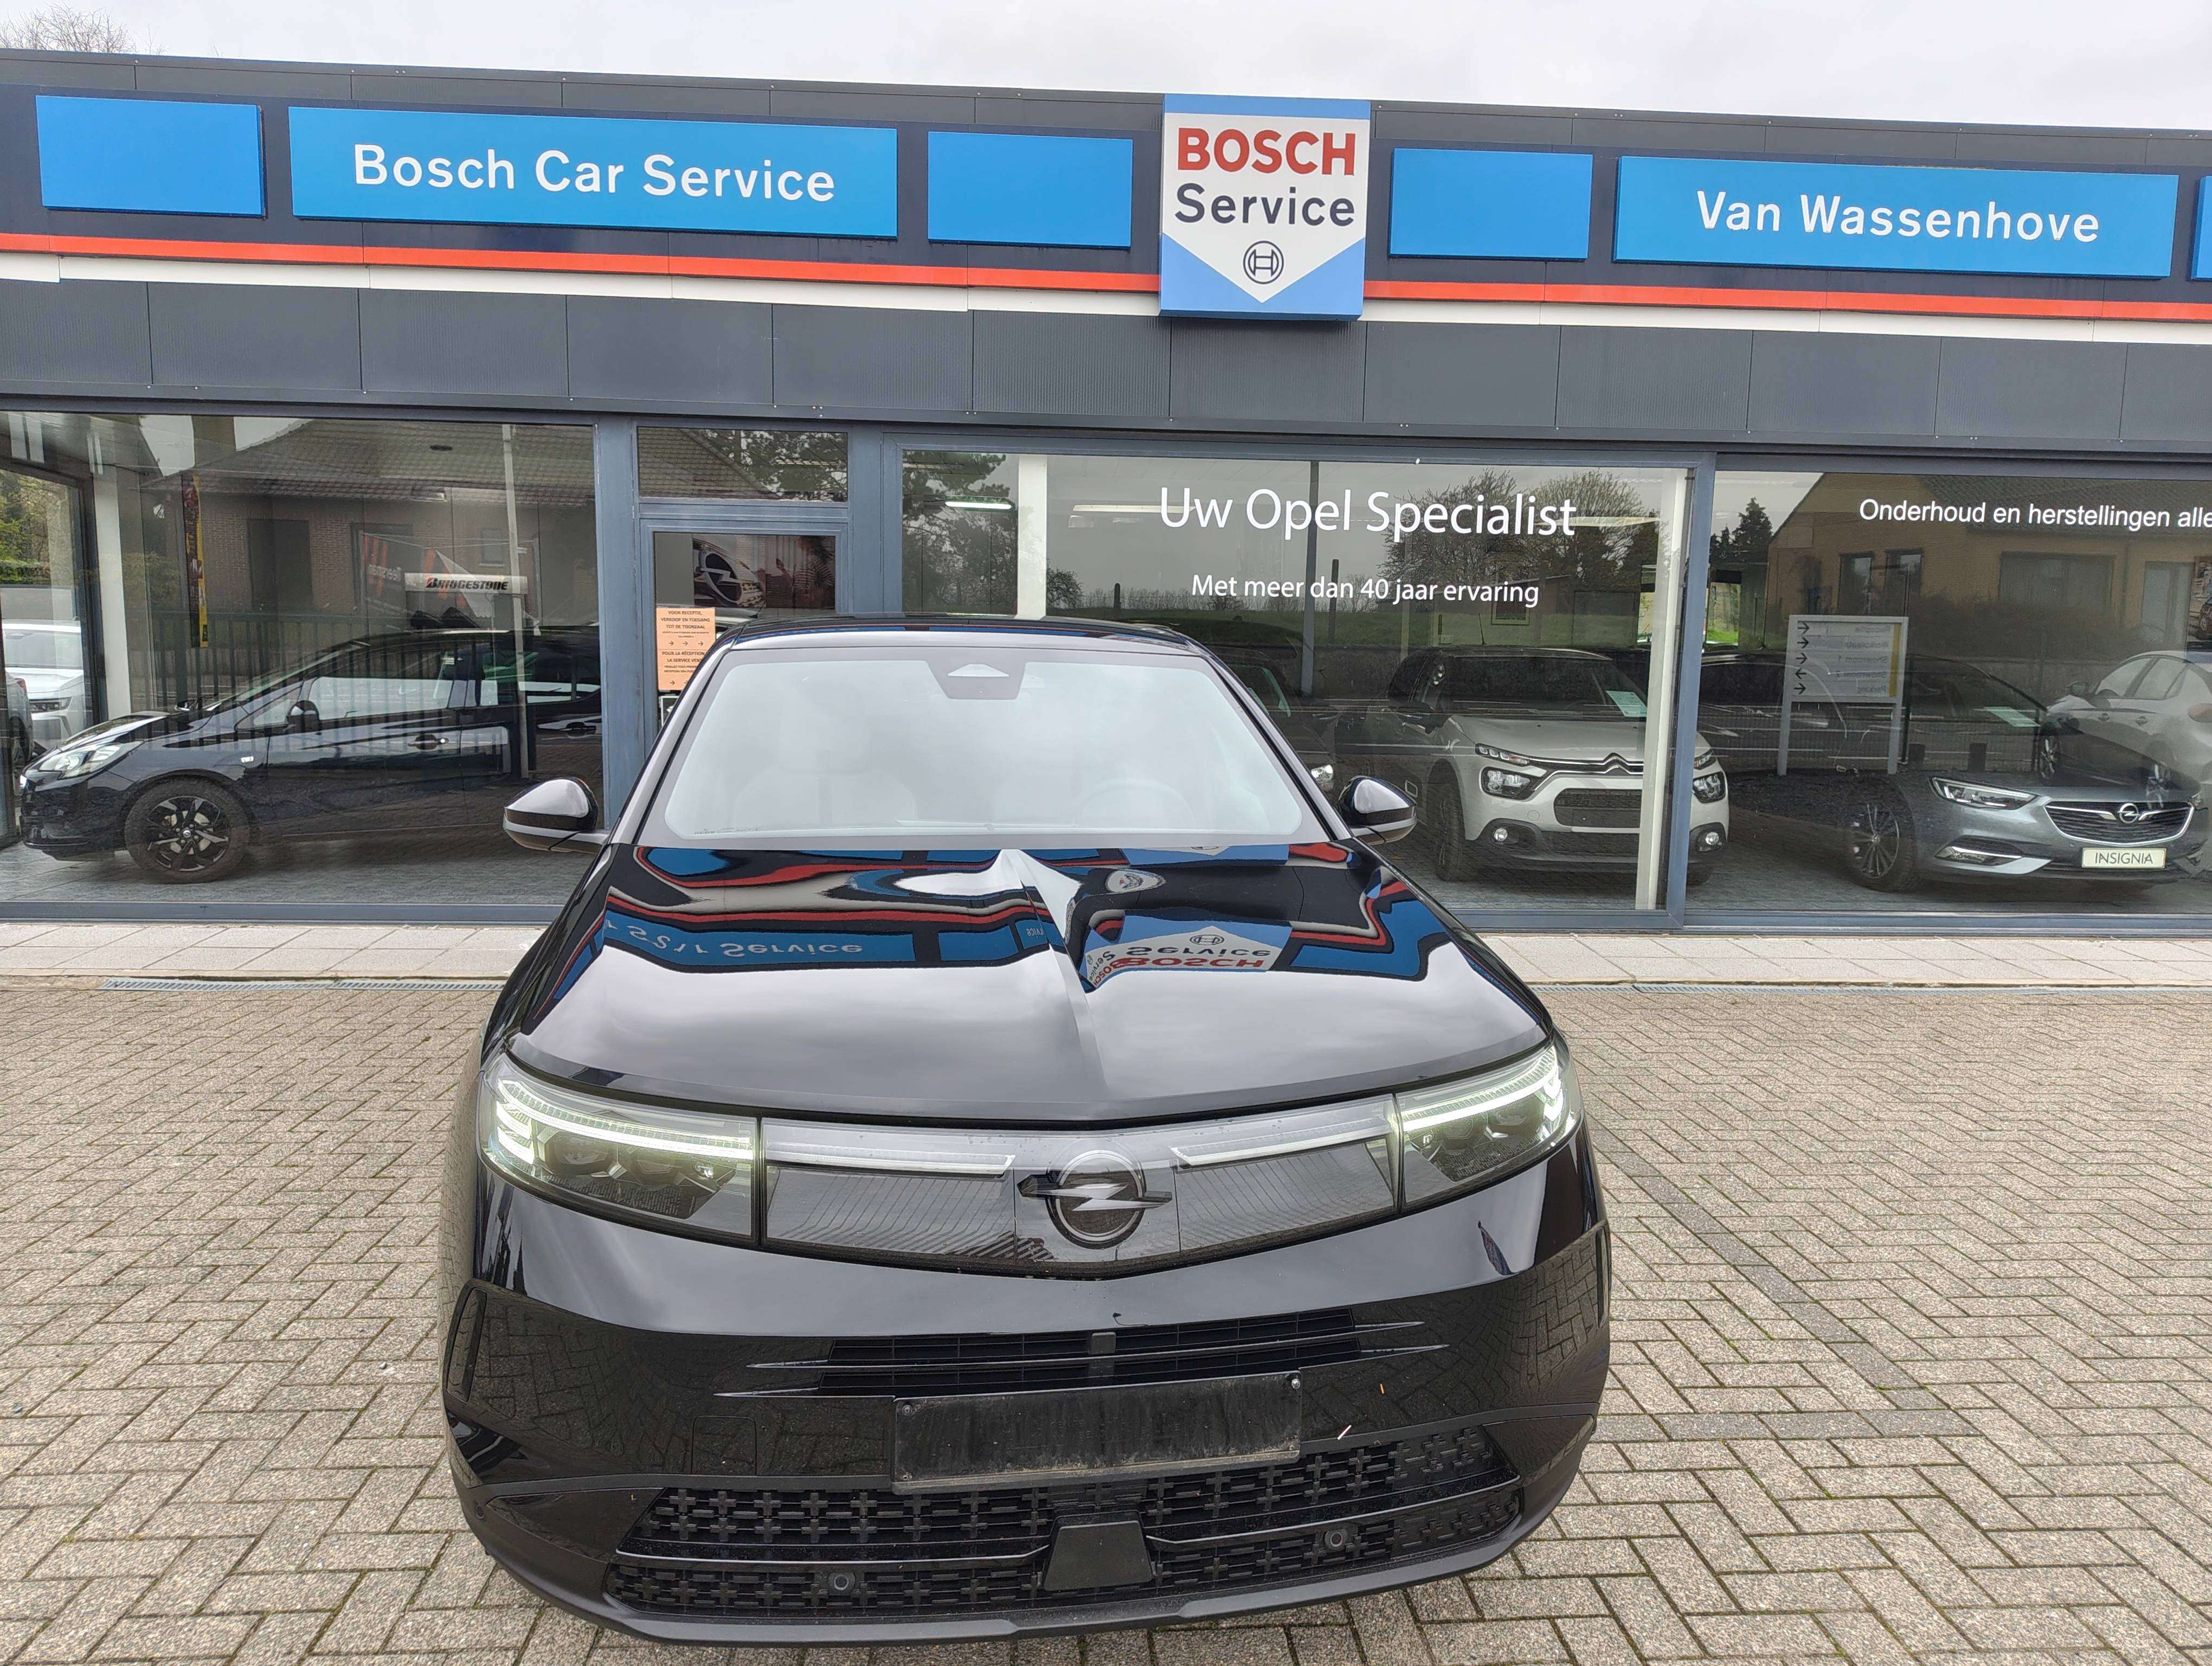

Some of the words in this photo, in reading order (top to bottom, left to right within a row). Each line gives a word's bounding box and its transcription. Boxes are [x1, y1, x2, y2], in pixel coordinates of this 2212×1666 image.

[354, 143, 515, 189] Bosch
[535, 149, 625, 194] Car
[643, 154, 835, 202] Service
[1178, 127, 1356, 176] BOSCH
[1174, 183, 1355, 227] Service
[1697, 190, 1780, 232] Van
[1800, 194, 2100, 242] Wassenhove
[1160, 486, 1233, 529] Uw
[1246, 489, 1352, 541] Opel
[1366, 491, 1577, 543] Specialist
[1859, 498, 1986, 523] Onderhoud
[1992, 507, 2021, 524] en
[2028, 503, 2170, 532] herstellingen
[425, 576, 509, 591] BRIDGESTONE
[1192, 574, 1238, 597] Met
[1244, 580, 1304, 598] meer
[1310, 575, 1354, 599] dan
[1360, 578, 1389, 600] 40
[1392, 579, 1438, 605] jaar
[1443, 581, 1539, 608] ervaring
[2095, 852, 2153, 864] INSIGNIA
